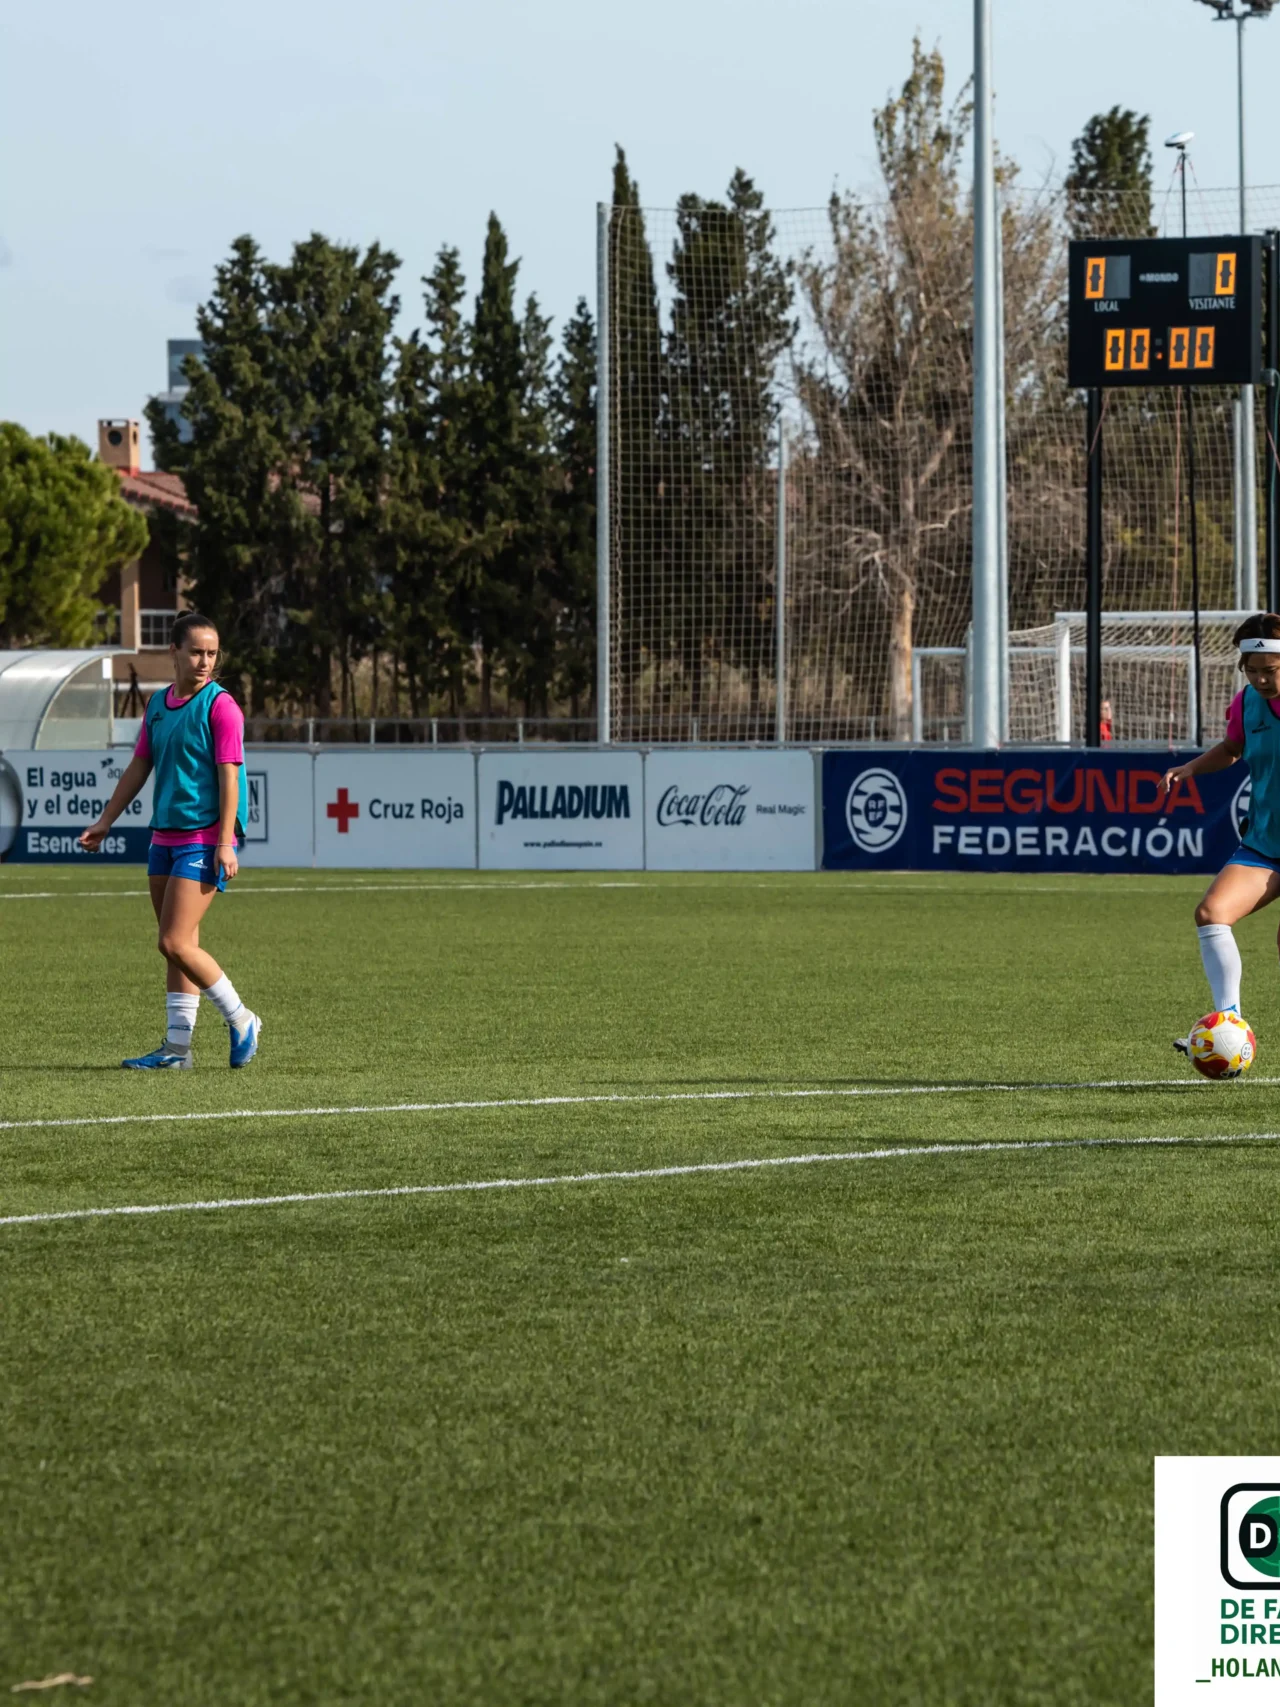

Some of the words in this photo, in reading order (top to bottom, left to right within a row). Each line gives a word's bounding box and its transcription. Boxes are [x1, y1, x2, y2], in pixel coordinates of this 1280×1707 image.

[1085, 257, 1106, 299] 0
[1215, 253, 1237, 295] 0
[1094, 301, 1120, 312] LOCAL
[1188, 297, 1236, 310] VISITANTE
[1105, 326, 1215, 371] 00:00
[27, 766, 44, 788] El
[50, 771, 97, 792] agua
[933, 768, 1206, 814] SEGUNDA
[27, 798, 38, 819] y
[44, 794, 61, 815] el
[67, 794, 143, 819] depe
[369, 798, 415, 820] Cruz
[421, 796, 464, 822] Roja
[495, 780, 630, 825] PALLADIUM
[656, 784, 751, 827] Coca-Cola
[756, 804, 776, 815] Real
[778, 804, 806, 817] Magic
[933, 818, 1204, 858] FEDERACIÓN
